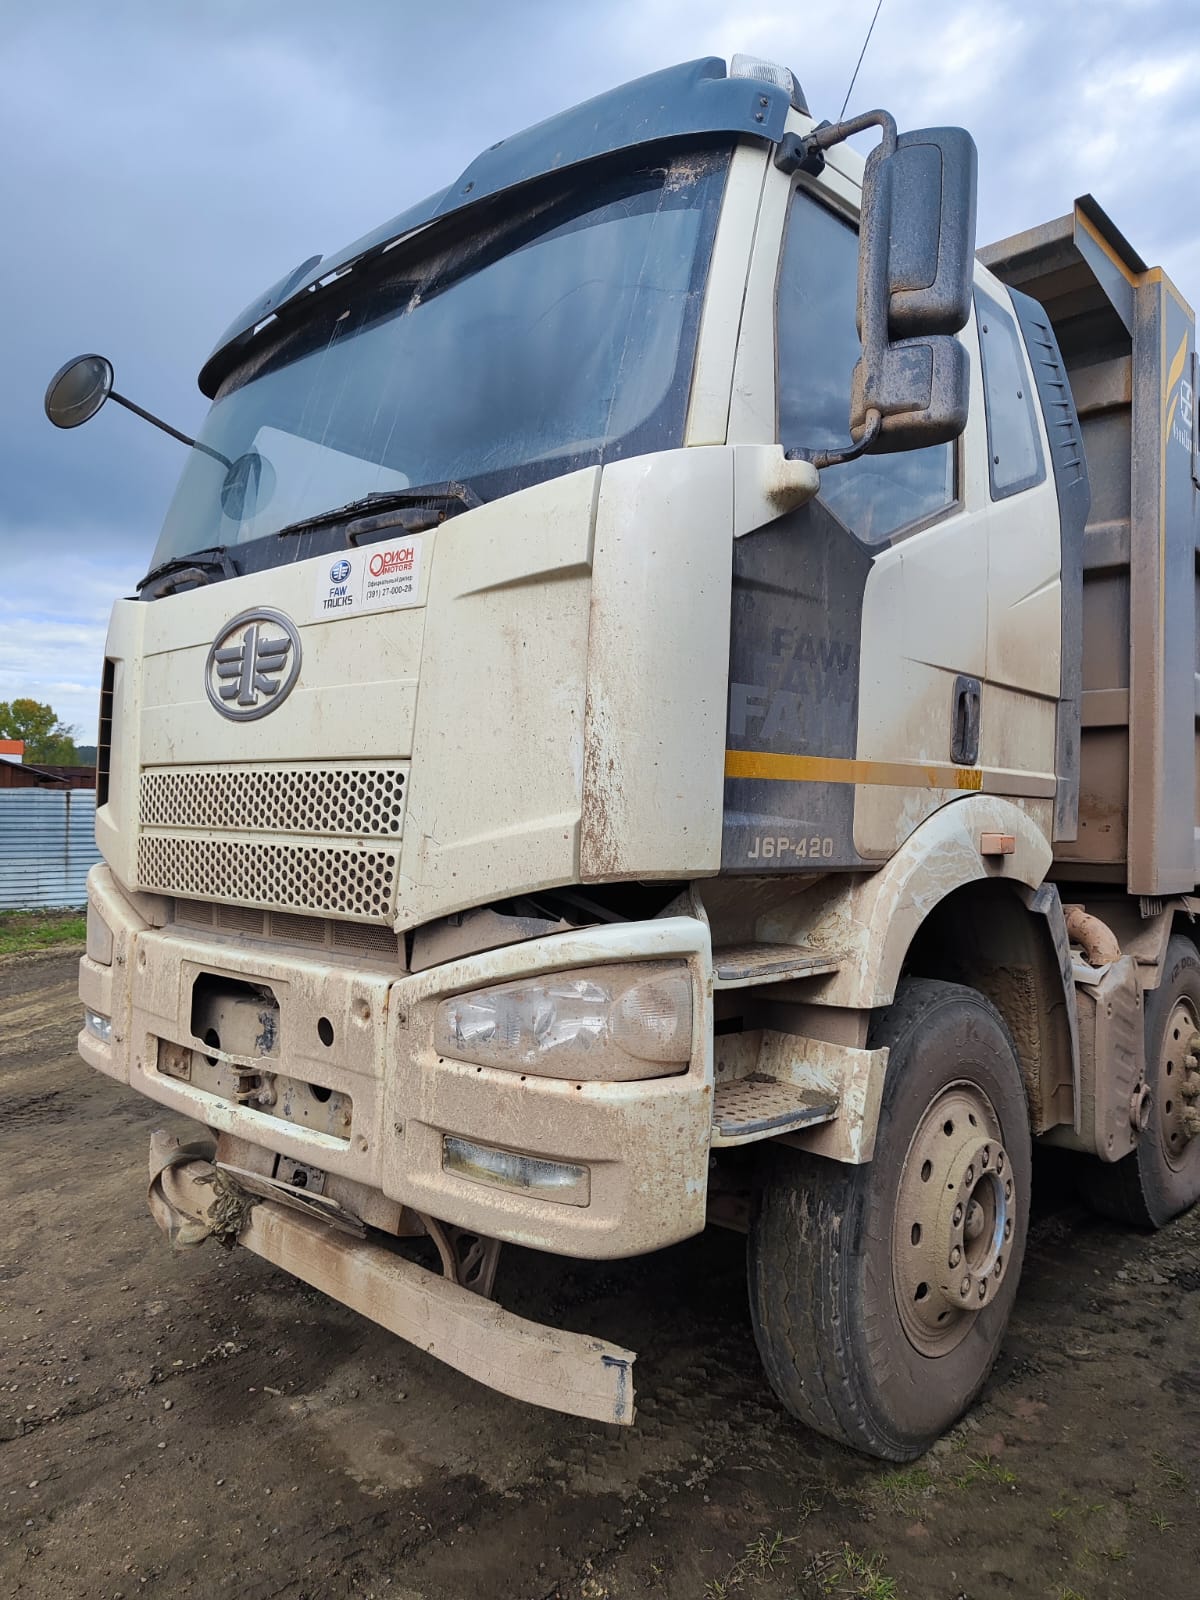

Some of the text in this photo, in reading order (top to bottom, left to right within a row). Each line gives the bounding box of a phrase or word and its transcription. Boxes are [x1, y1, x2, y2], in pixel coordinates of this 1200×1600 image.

[384, 562, 413, 574] MOTORS
[330, 586, 347, 597] FAW
[366, 589, 381, 601] (391)
[323, 595, 353, 610] TRUCKS
[771, 627, 853, 676] FAW
[748, 837, 834, 859] J6P-420
